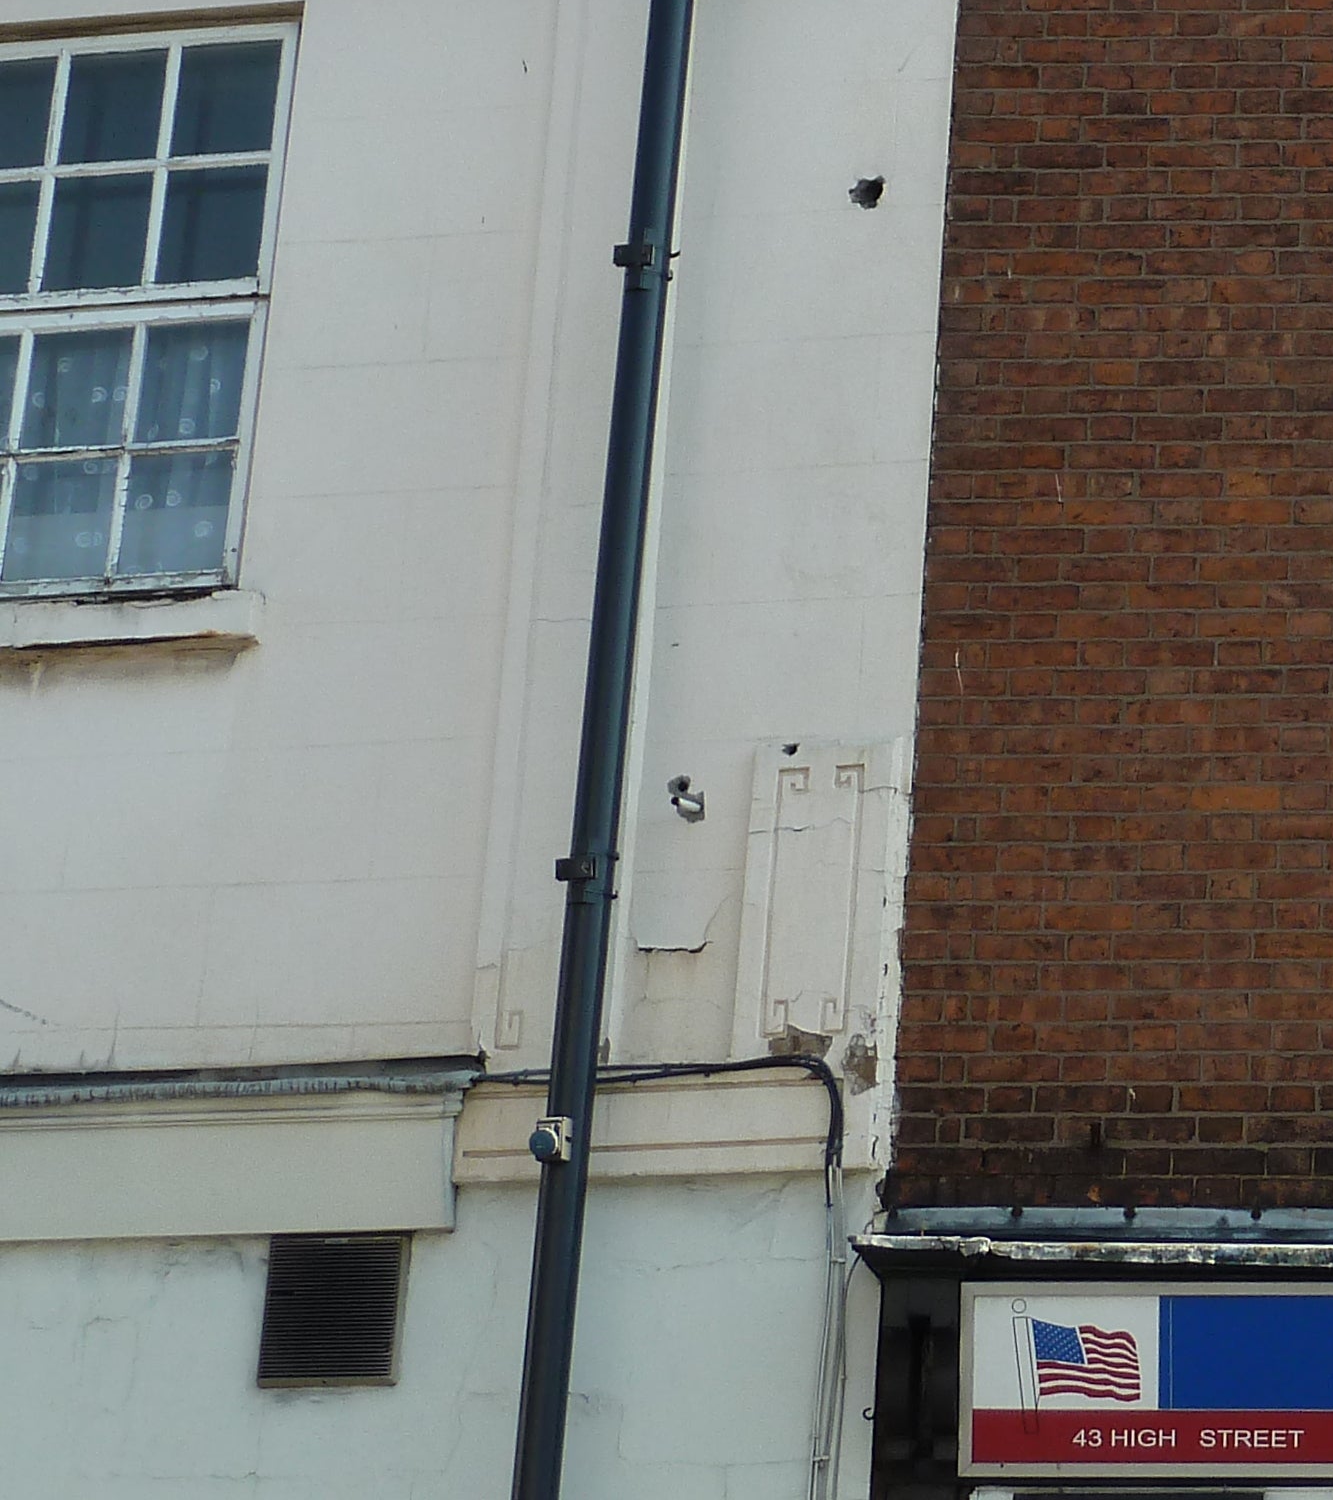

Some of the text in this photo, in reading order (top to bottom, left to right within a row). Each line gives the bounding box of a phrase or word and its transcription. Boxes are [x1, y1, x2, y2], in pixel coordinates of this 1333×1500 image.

[1072, 1429, 1305, 1449] 43 HIGH STREET
